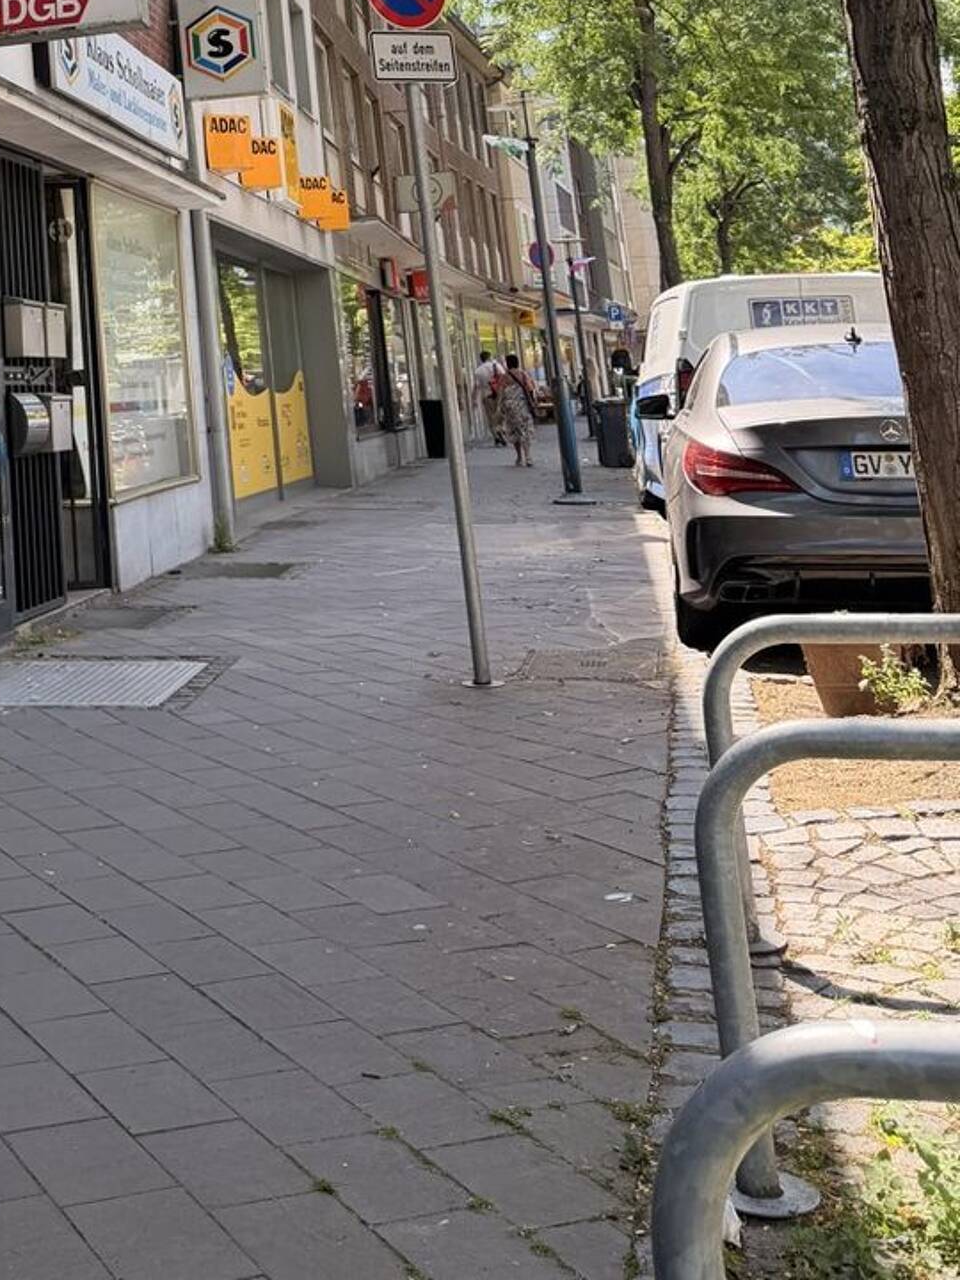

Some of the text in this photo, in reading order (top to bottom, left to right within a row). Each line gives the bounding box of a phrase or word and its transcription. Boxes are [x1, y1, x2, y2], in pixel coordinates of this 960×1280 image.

[206, 28, 234, 59] S
[390, 42, 435, 56] auf dem
[378, 57, 451, 73] Seitenstreifen
[209, 117, 248, 134] ADAC
[251, 139, 277, 155] DAC
[299, 176, 328, 191] ADAC
[331, 191, 346, 204] AC
[610, 306, 620, 319] P
[853, 453, 882, 475] GV
